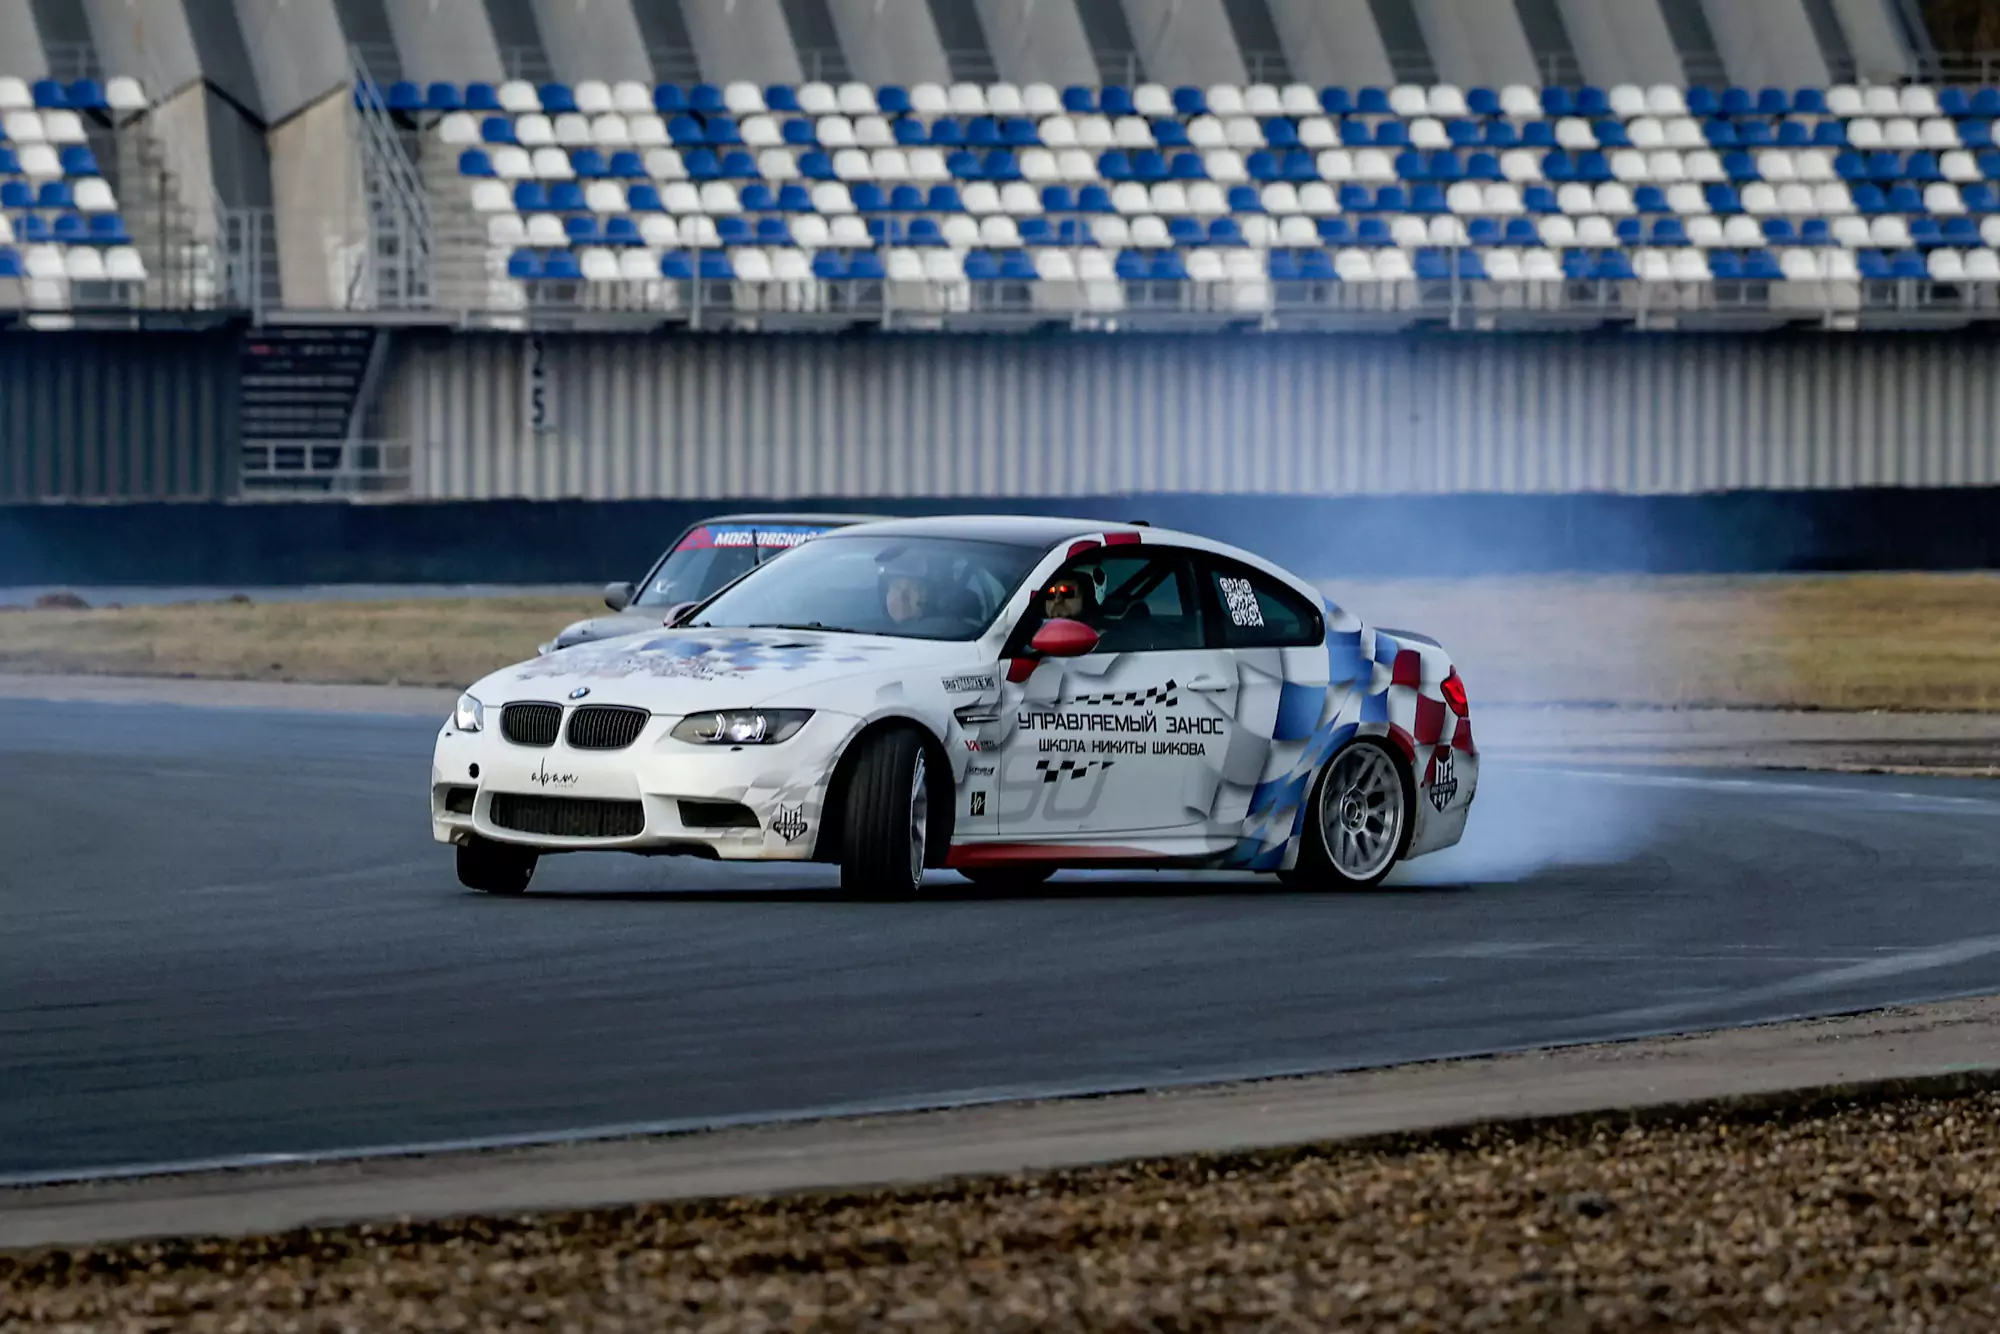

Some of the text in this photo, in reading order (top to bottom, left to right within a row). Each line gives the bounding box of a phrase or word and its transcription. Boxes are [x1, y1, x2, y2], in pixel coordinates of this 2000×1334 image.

[1018, 710, 1224, 735] УПРАВЛЯЕМЫЙ ЗАНОС
[1038, 738, 1206, 756] ШКОЛА НИКИТЫ ШИКОВА
